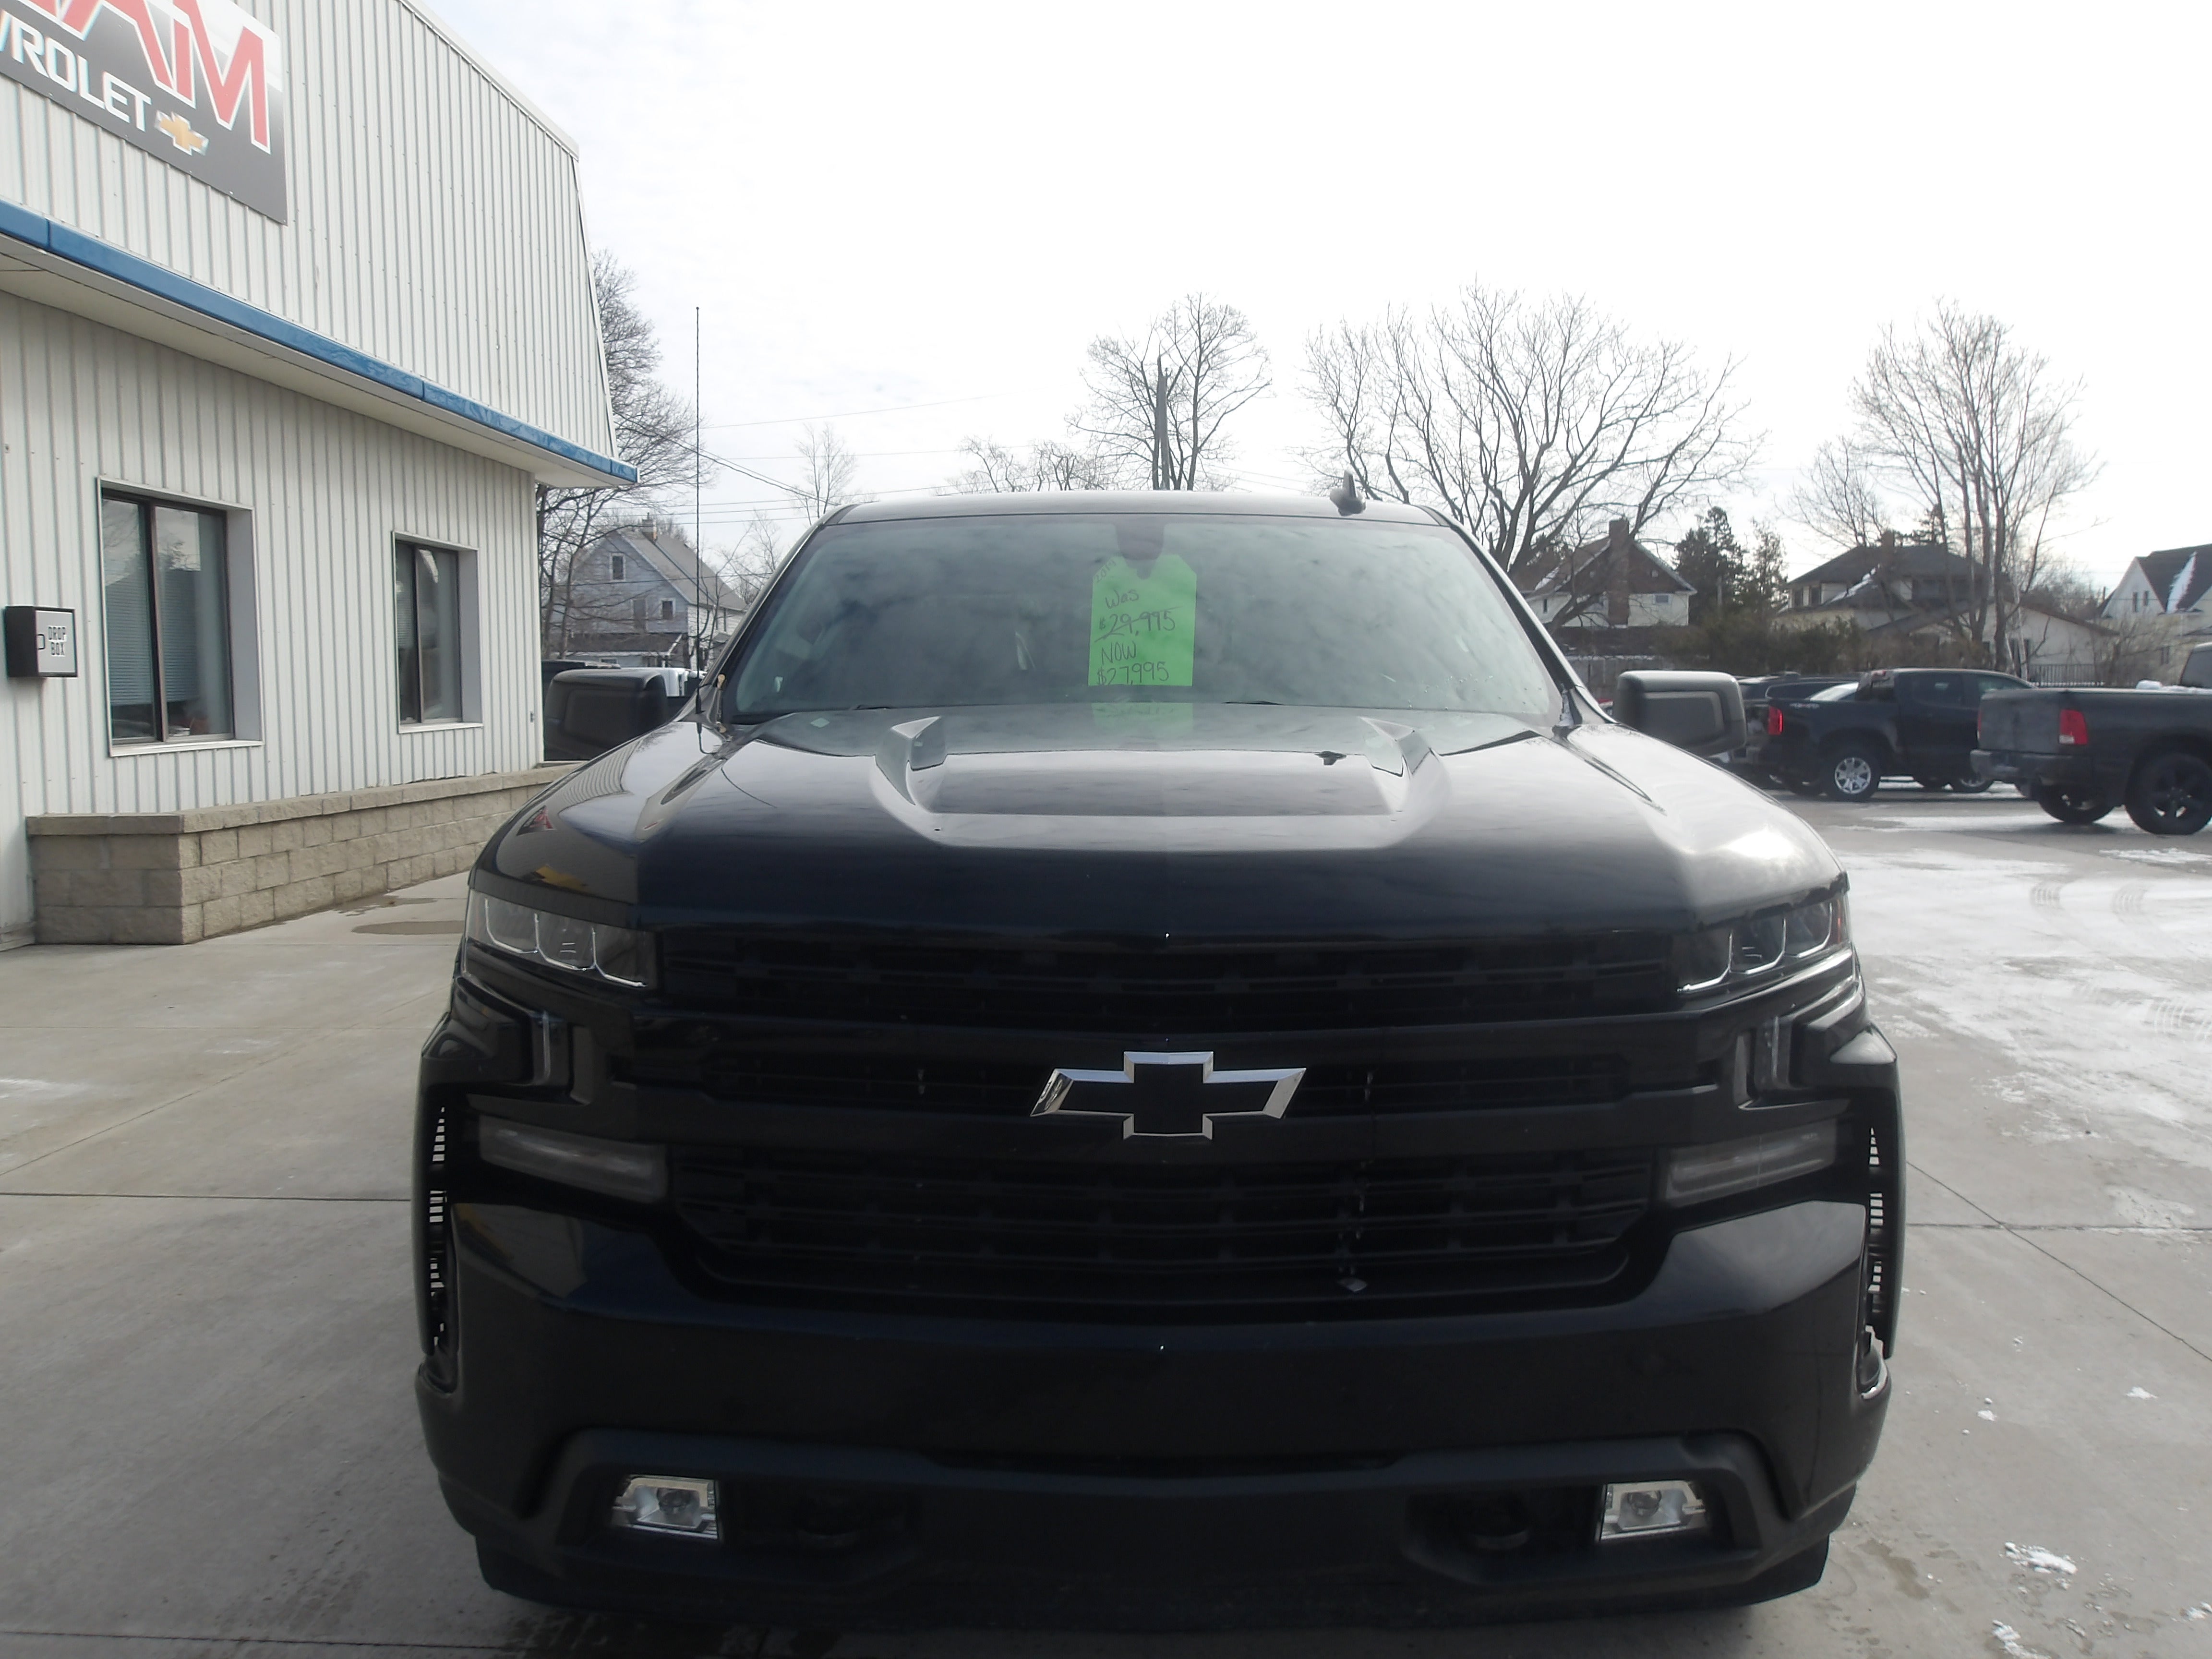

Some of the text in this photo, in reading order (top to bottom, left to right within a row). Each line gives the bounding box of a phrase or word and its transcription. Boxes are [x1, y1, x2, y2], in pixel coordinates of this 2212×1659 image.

[48, 626, 66, 640] DROP
[51, 641, 65, 656] BOX
[1101, 641, 1136, 664] NOW
[1096, 661, 1169, 685] $27,995
